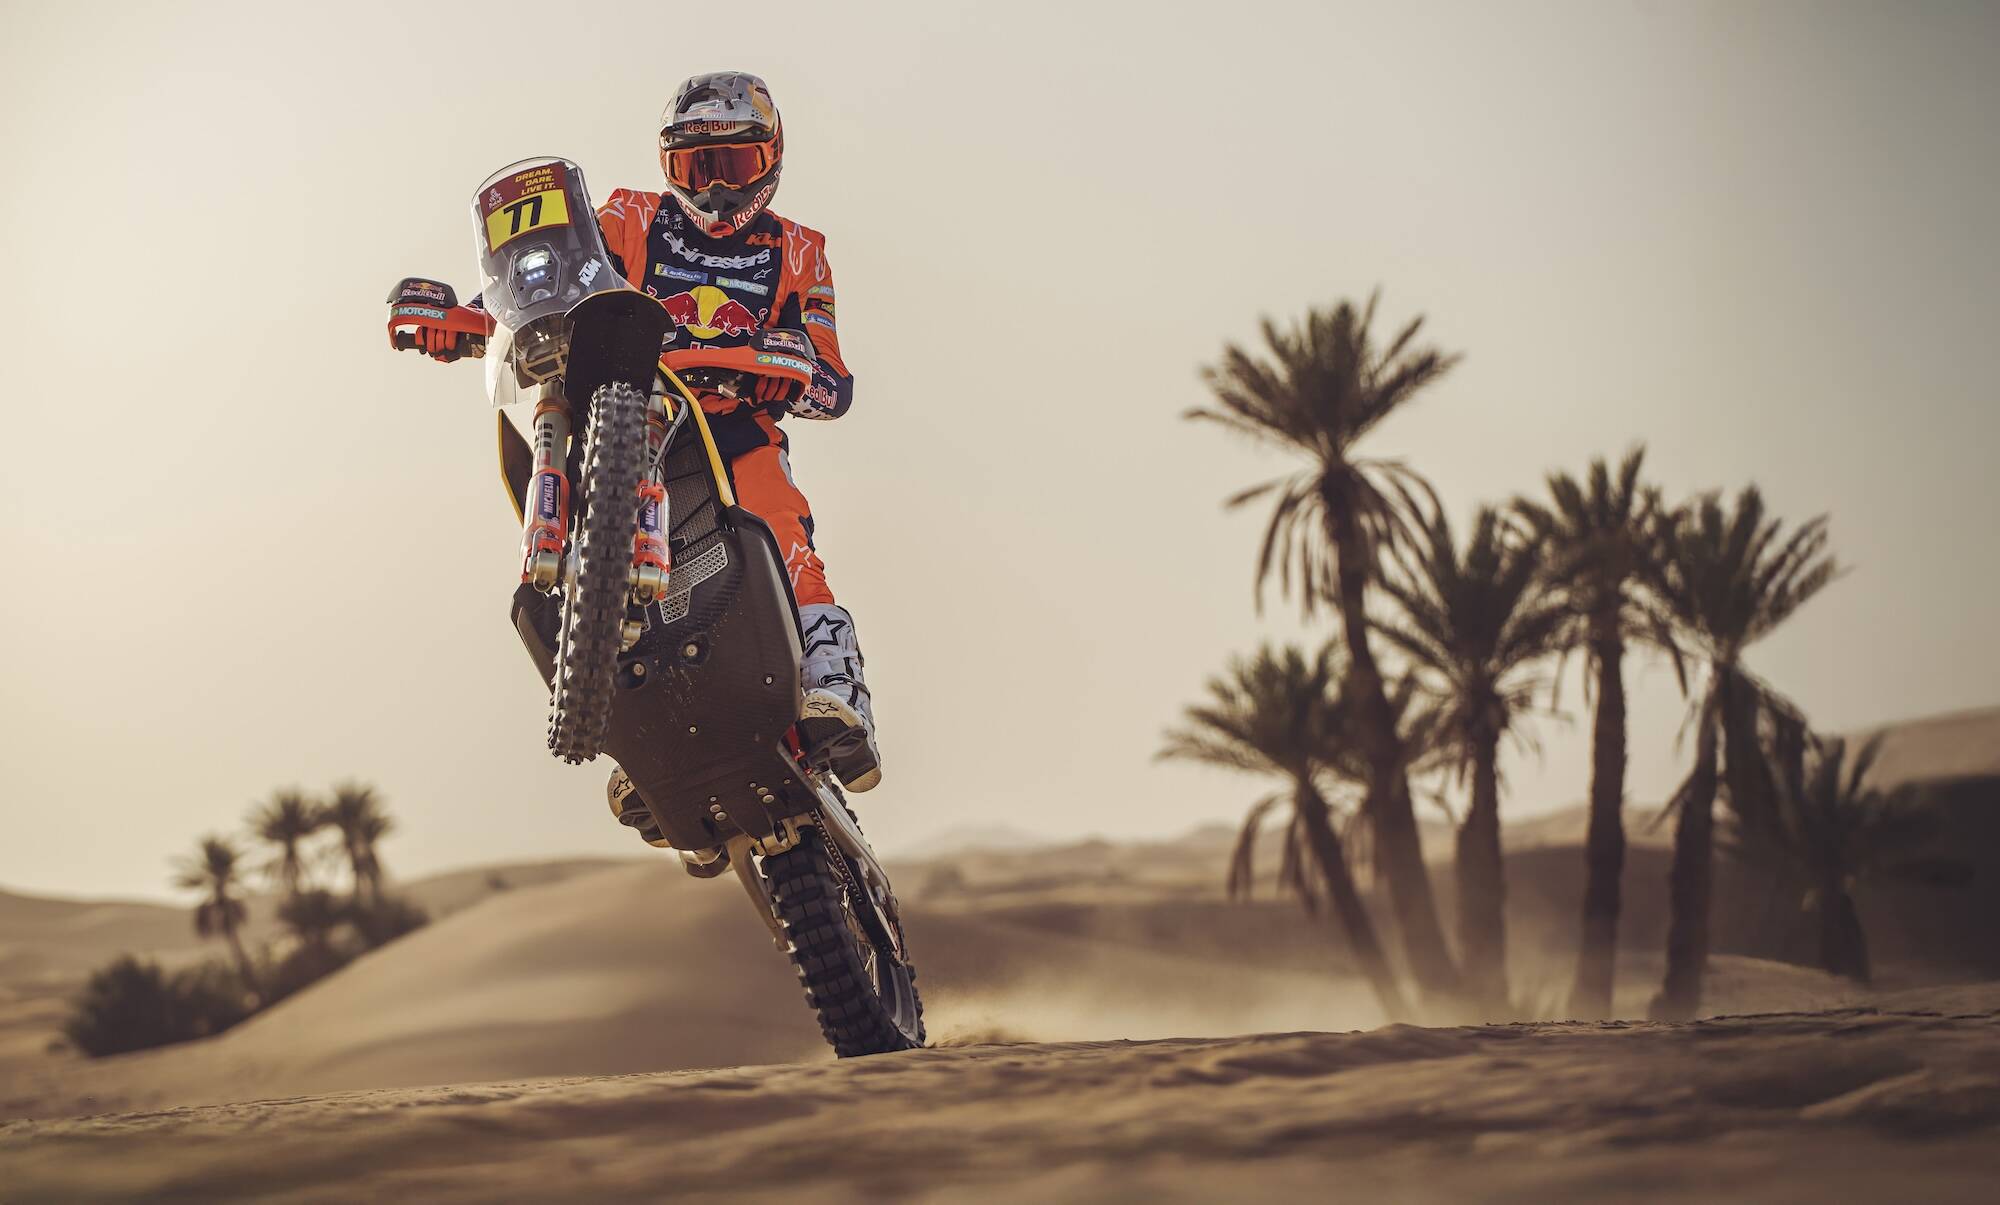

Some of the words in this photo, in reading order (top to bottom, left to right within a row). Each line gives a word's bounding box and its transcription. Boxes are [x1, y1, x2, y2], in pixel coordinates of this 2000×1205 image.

[711, 120, 736, 132] Bull
[515, 168, 553, 183] DREAM.
[525, 175, 555, 187] DARE.
[521, 184, 542, 195] LIVE
[503, 195, 543, 236] 77
[578, 257, 602, 287] KTM
[399, 307, 444, 320] MOTOREX
[543, 475, 554, 514] MICHELIN
